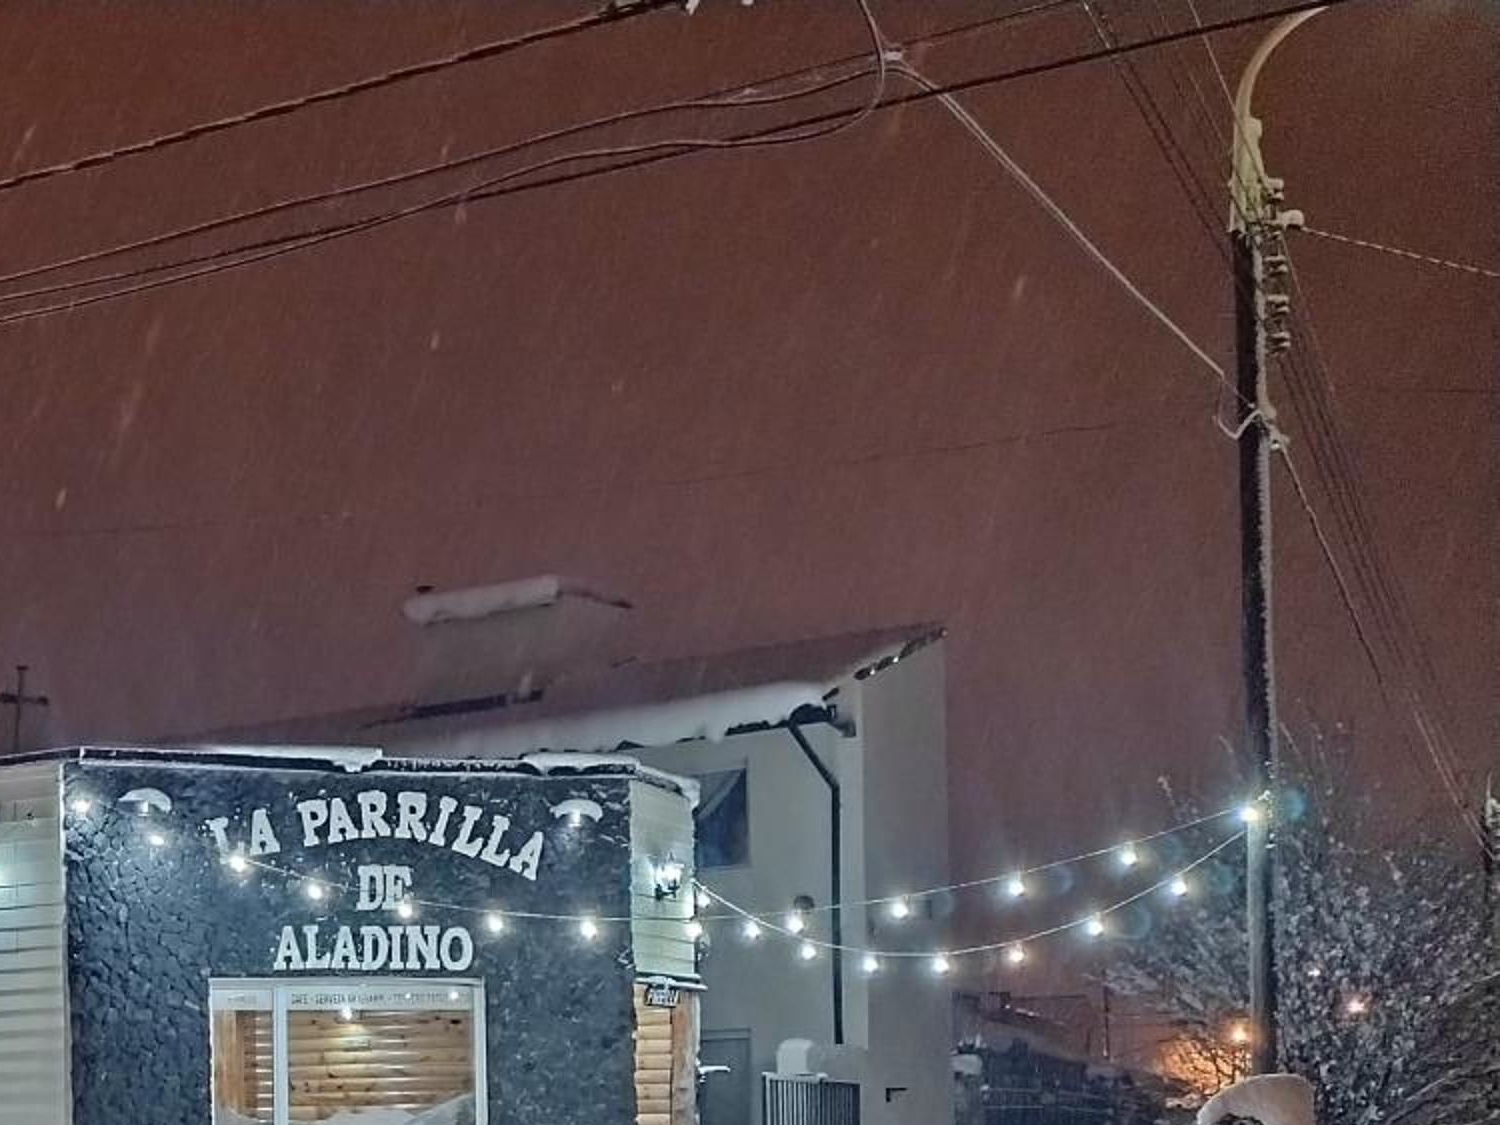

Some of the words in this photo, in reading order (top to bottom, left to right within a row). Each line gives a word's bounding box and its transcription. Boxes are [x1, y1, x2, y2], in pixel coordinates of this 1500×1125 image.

[209, 808, 281, 864] LA
[297, 789, 545, 881] PARRILLA
[356, 864, 412, 911] DE
[273, 925, 474, 971] ALADINO
